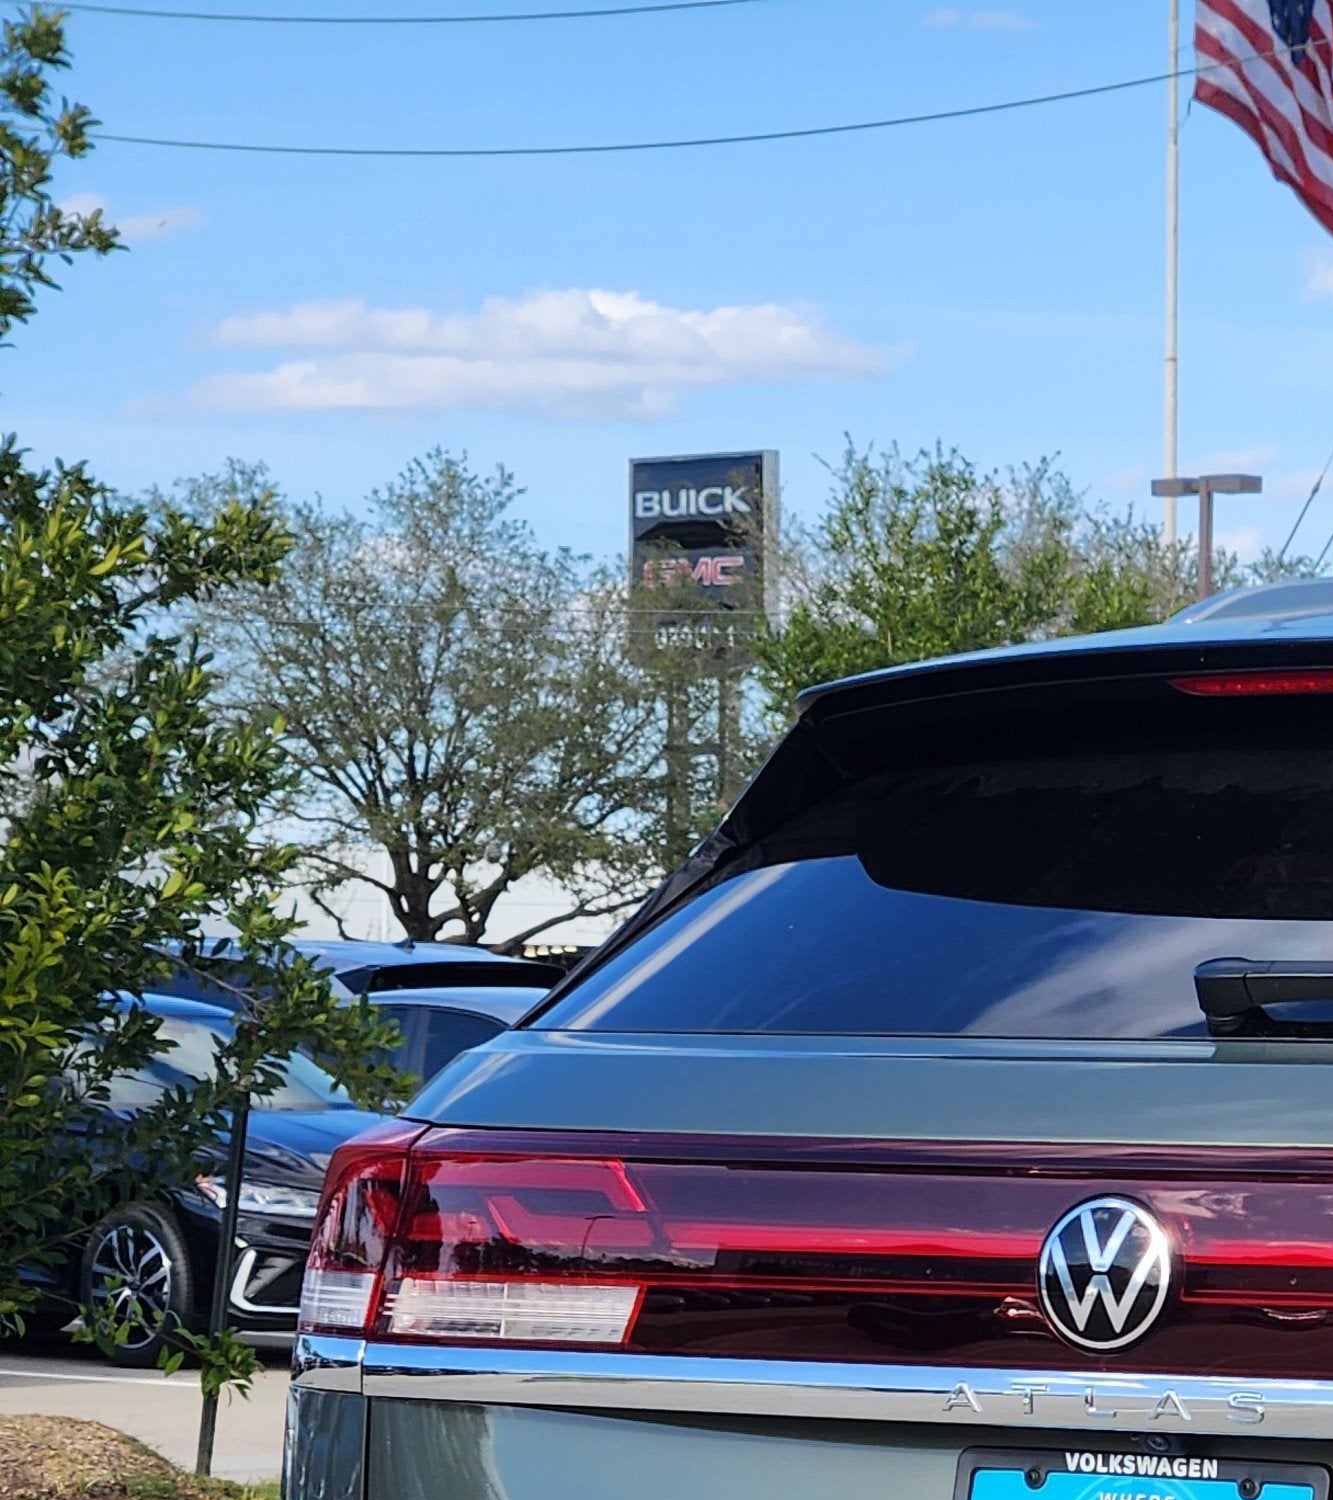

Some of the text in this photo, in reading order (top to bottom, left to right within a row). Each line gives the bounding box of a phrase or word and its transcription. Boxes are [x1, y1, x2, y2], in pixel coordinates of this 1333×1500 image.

[635, 486, 750, 518] BUICK
[643, 556, 744, 588] GMC
[942, 1380, 1266, 1425] ATLAS
[1064, 1452, 1219, 1479] VOLKSWAGEN
